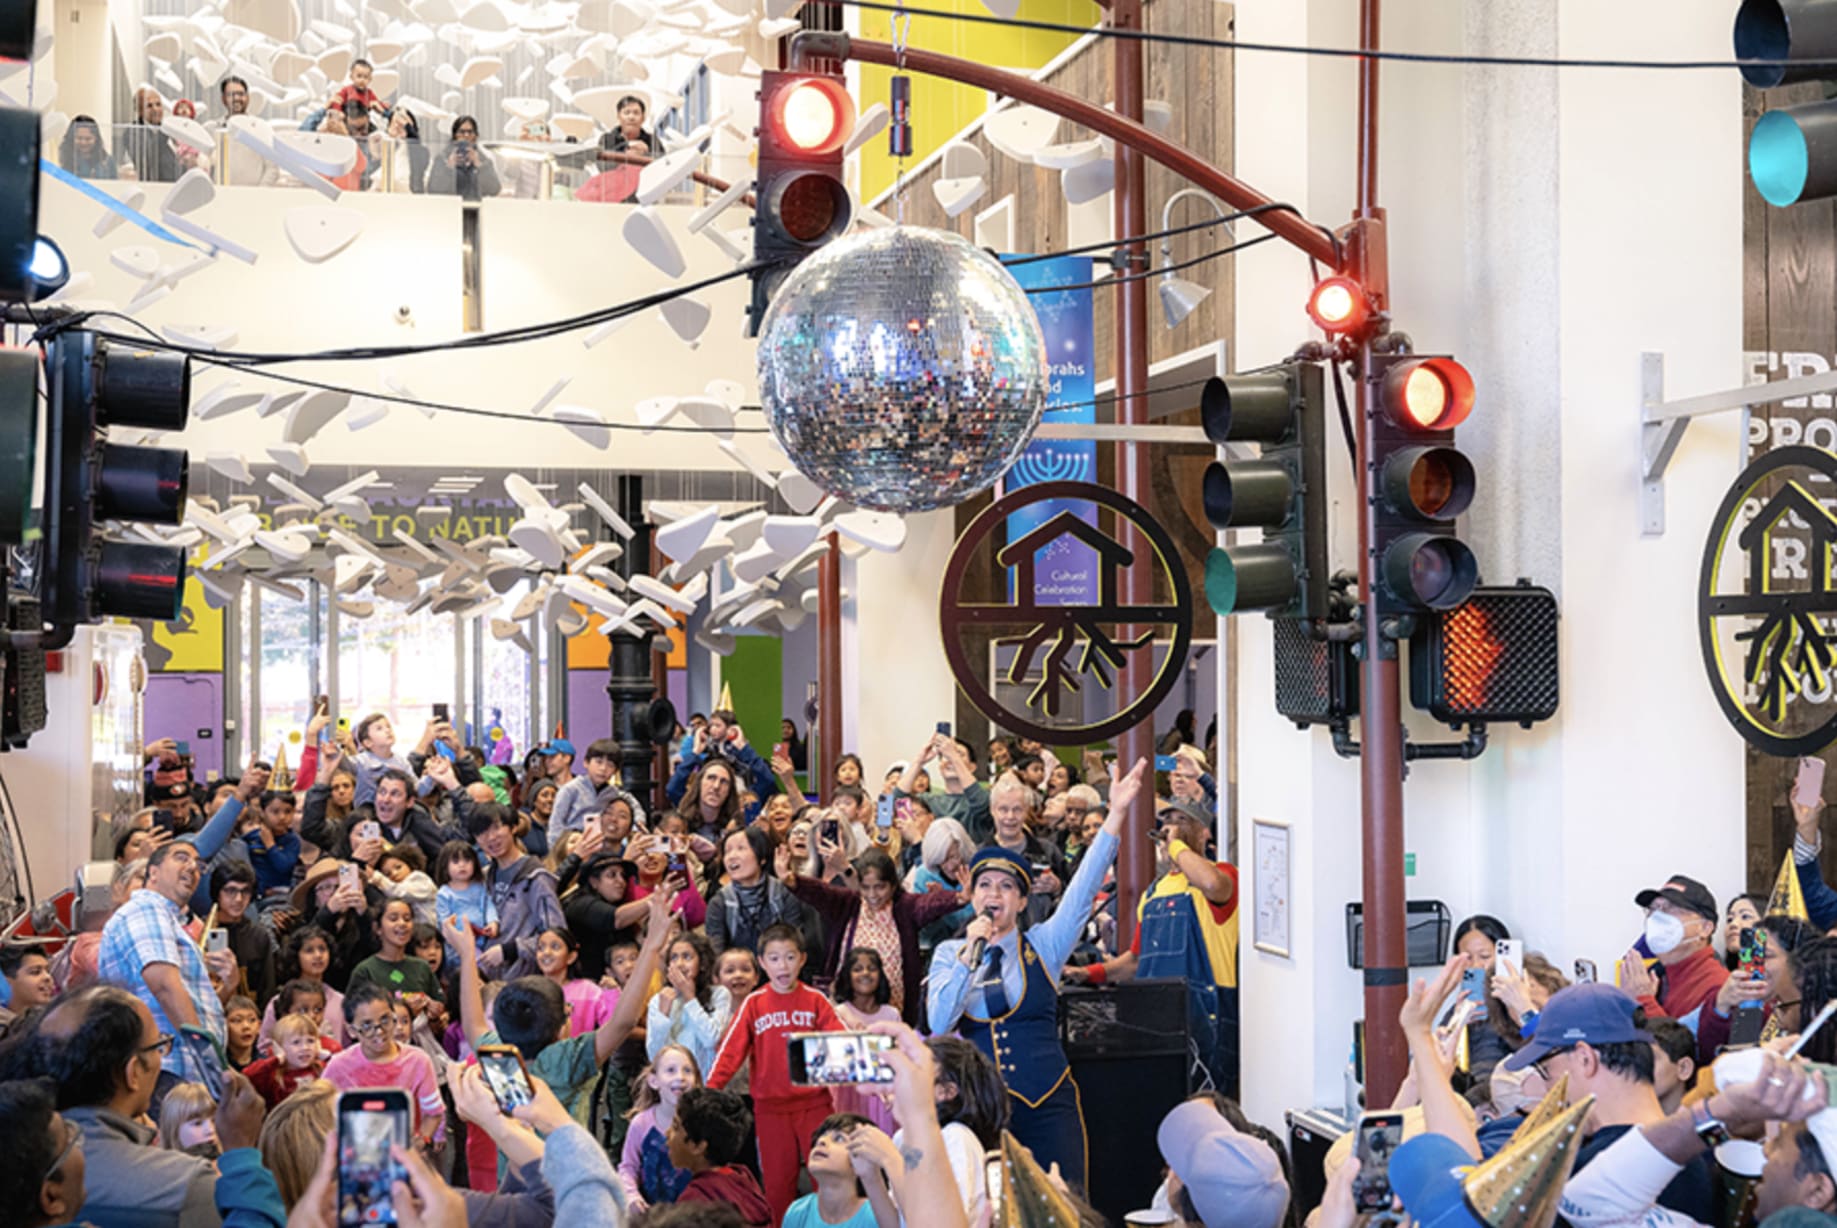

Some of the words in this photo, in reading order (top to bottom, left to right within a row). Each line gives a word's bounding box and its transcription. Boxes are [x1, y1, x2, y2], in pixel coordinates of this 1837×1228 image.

[370, 515, 416, 539] TO
[429, 515, 525, 540] NATU
[1050, 570, 1088, 582] Cultural
[1033, 584, 1088, 596] Celebration
[754, 1011, 790, 1034] SEOUL
